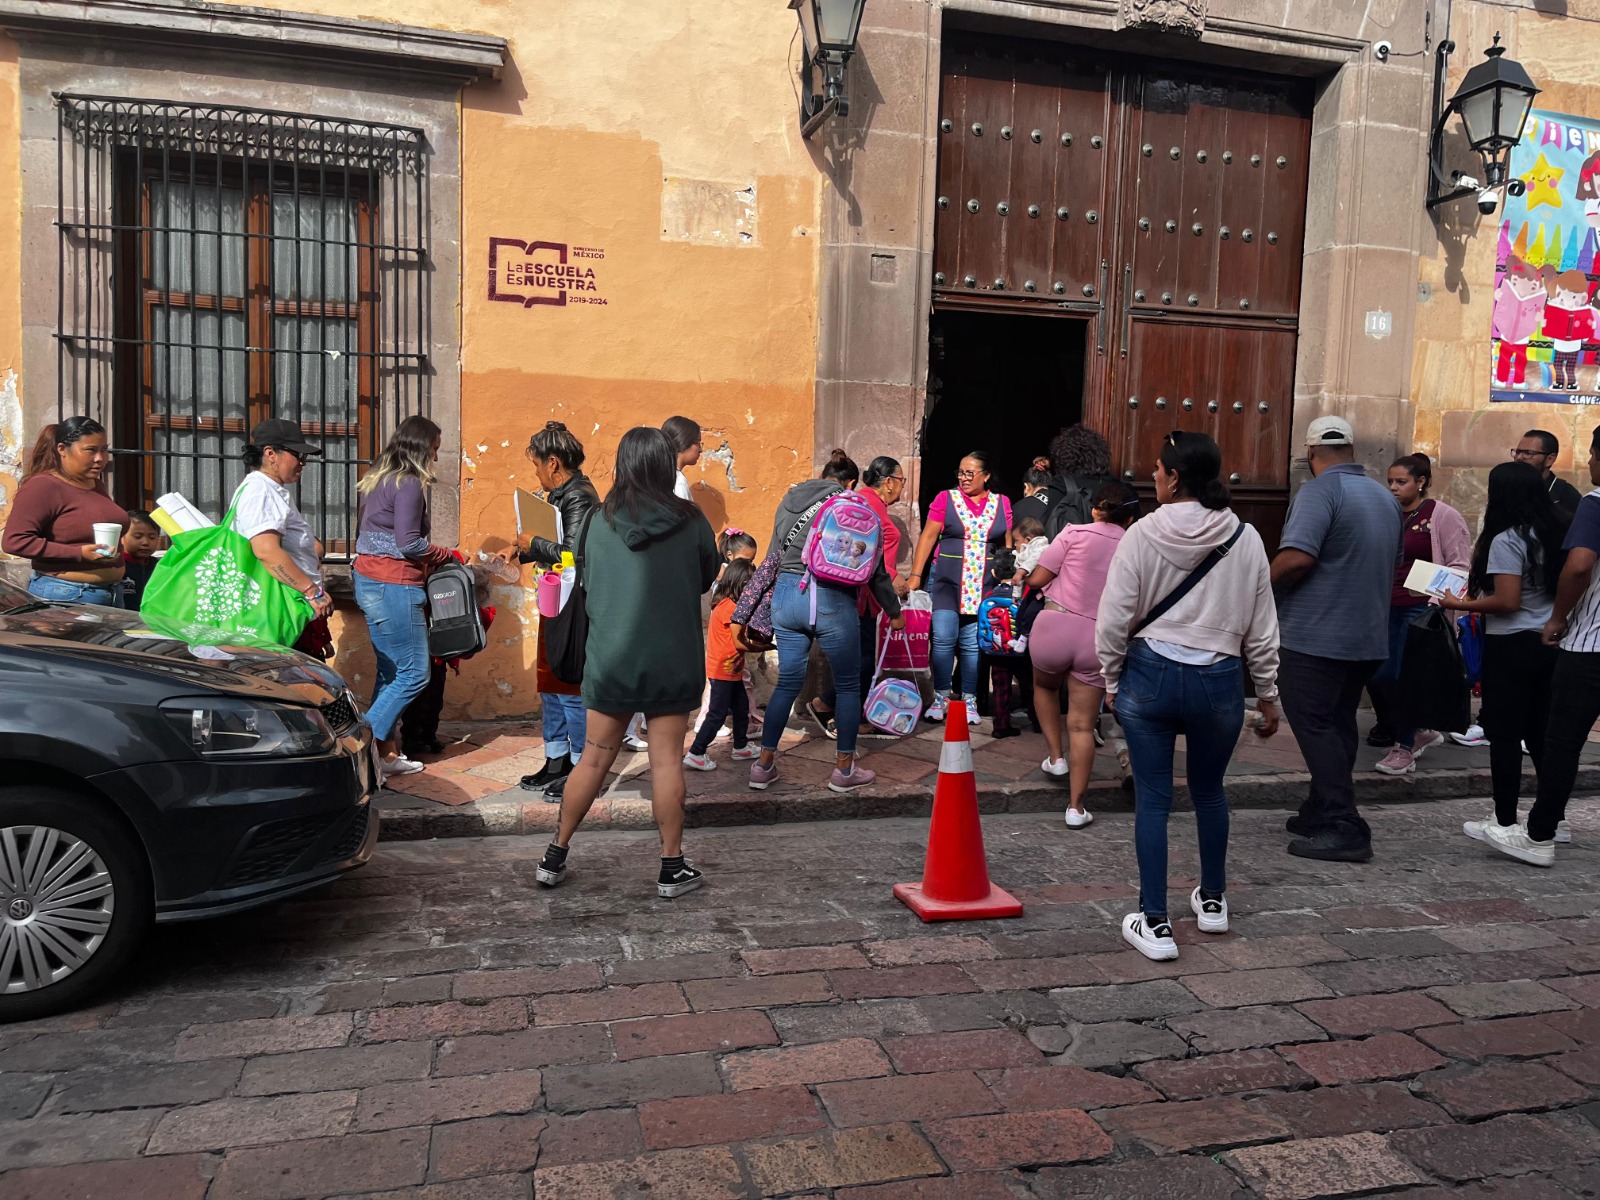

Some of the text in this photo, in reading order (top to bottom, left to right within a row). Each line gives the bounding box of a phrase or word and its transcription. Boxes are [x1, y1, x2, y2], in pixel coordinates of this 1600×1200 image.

[573, 250, 605, 259] MÉXICO
[568, 296, 608, 305] 2019-2024
[1371, 316, 1386, 331] 16
